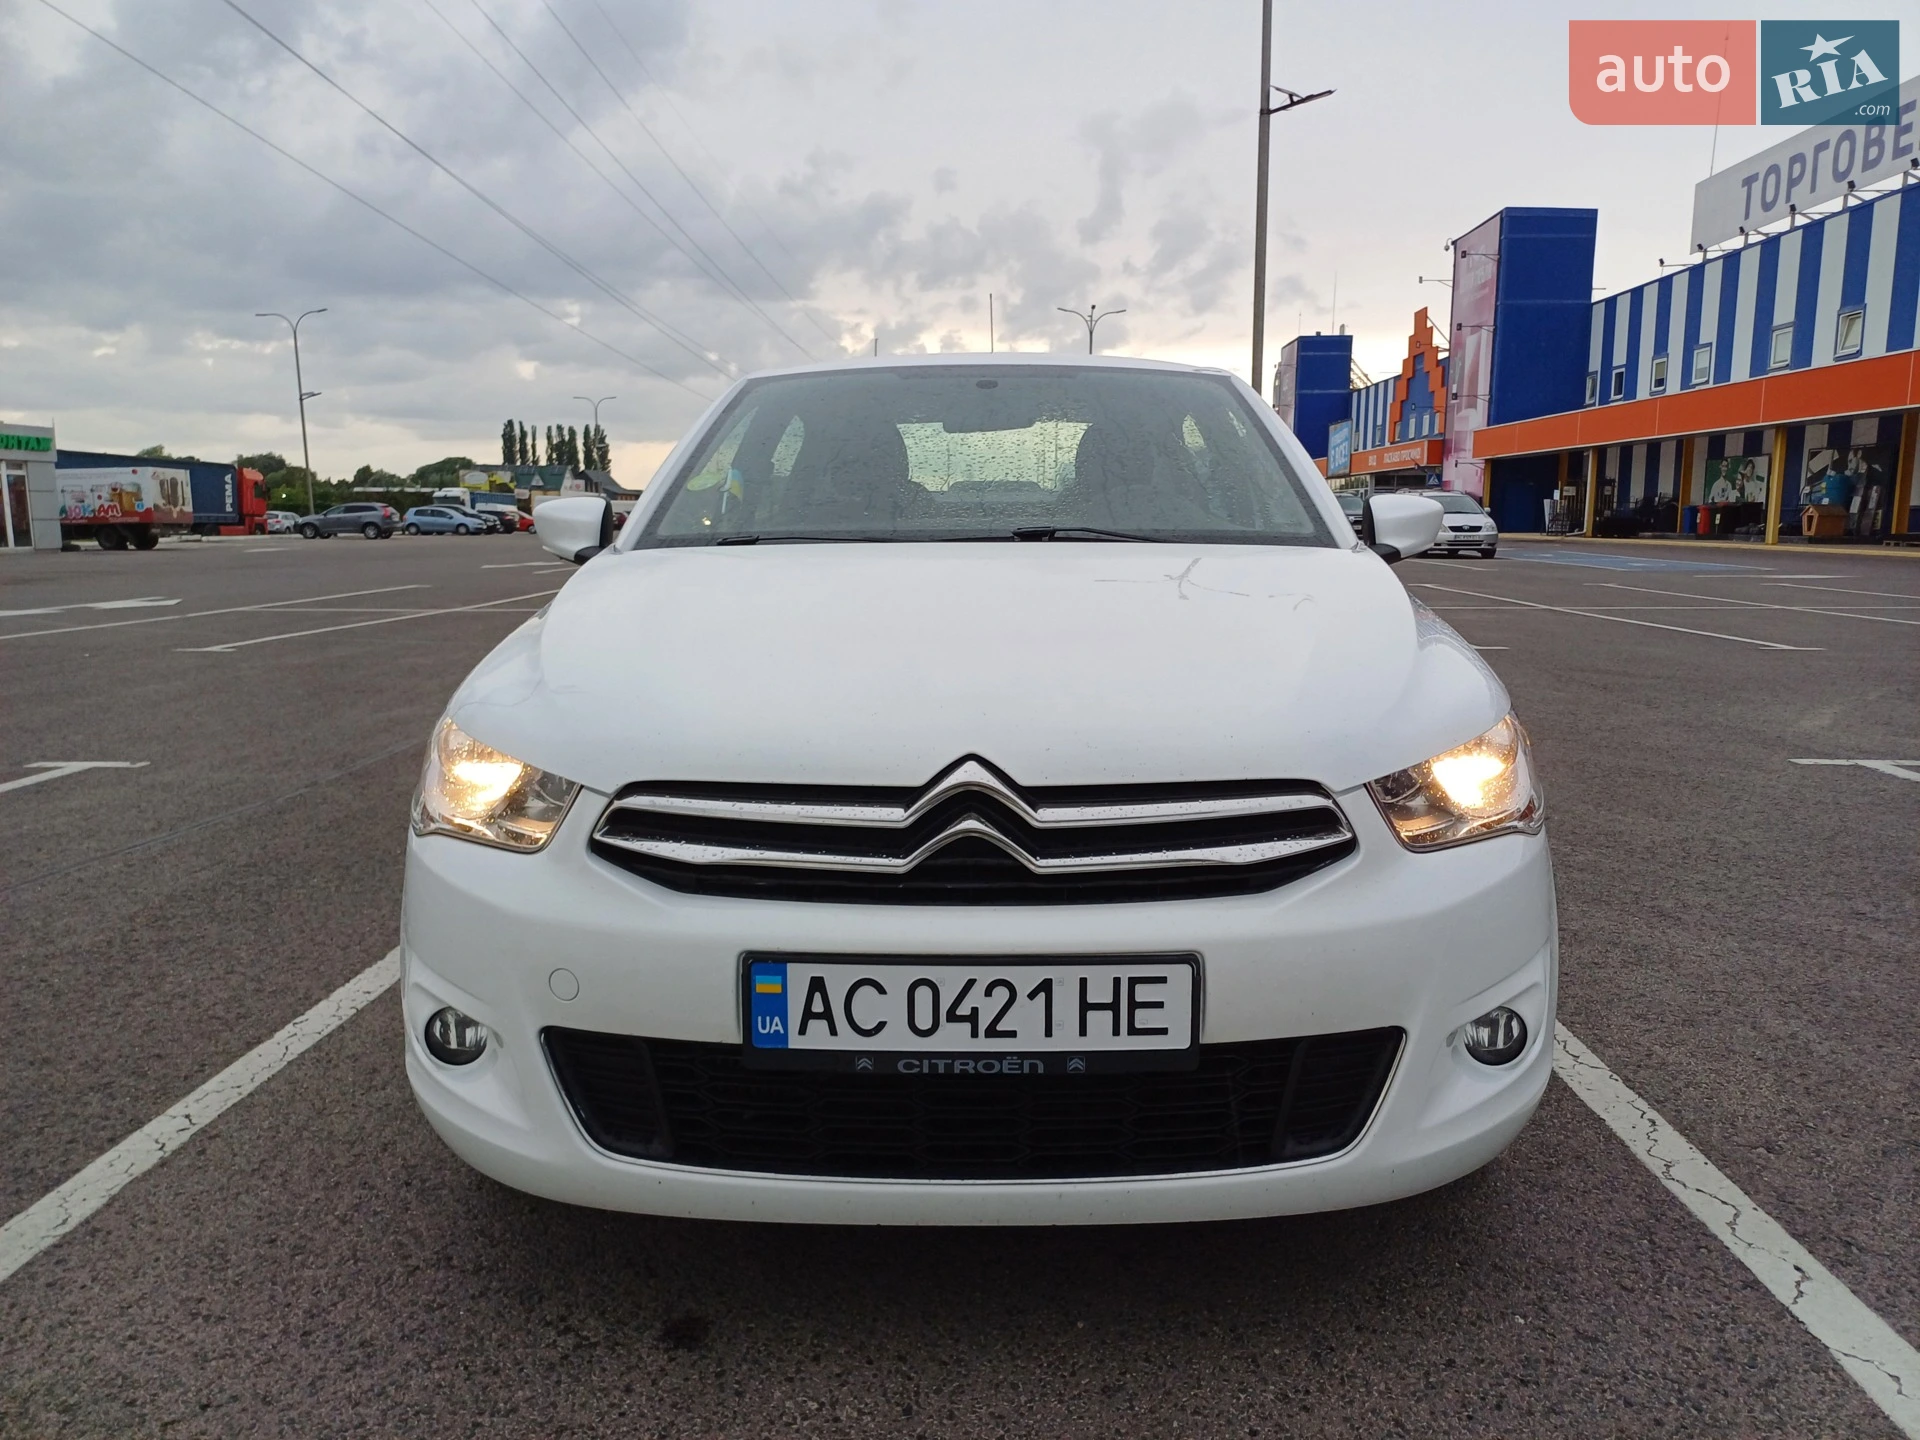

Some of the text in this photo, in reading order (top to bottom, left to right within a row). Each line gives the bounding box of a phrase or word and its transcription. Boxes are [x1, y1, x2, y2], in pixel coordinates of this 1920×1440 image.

[1741, 98, 1920, 222] ТОРГОВЕ
[224, 473, 234, 513] PEMA
[757, 1016, 785, 1034] UA
[798, 976, 1169, 1039] AC 0421 HE
